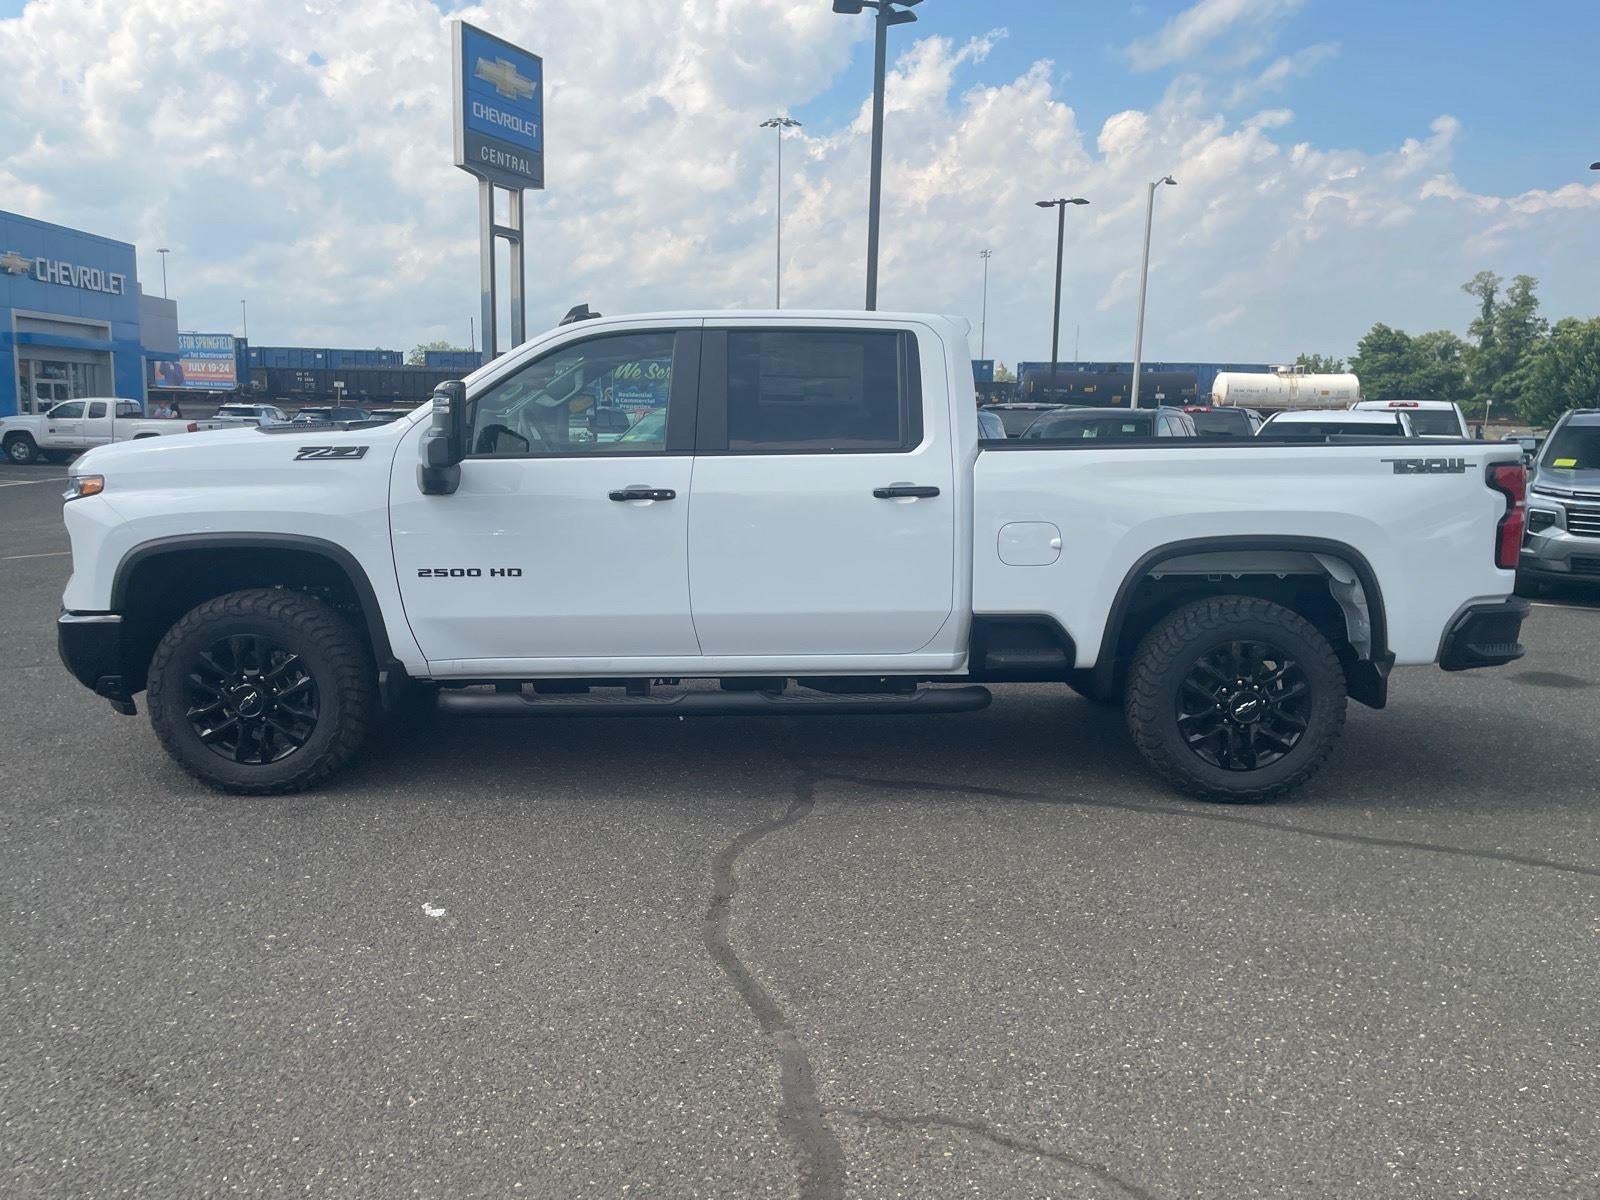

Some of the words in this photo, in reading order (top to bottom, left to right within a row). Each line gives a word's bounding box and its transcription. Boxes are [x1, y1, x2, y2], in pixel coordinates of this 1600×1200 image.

[473, 102, 538, 138] CHEVROLET
[481, 146, 532, 174] CENTRAL
[36, 257, 126, 295] CHEVROLET
[183, 335, 195, 349] FOR
[195, 335, 233, 350] SPRINGFIELD
[188, 362, 206, 372] JULY
[614, 362, 641, 380] We
[417, 568, 482, 578] 2500
[490, 568, 523, 578] HD
